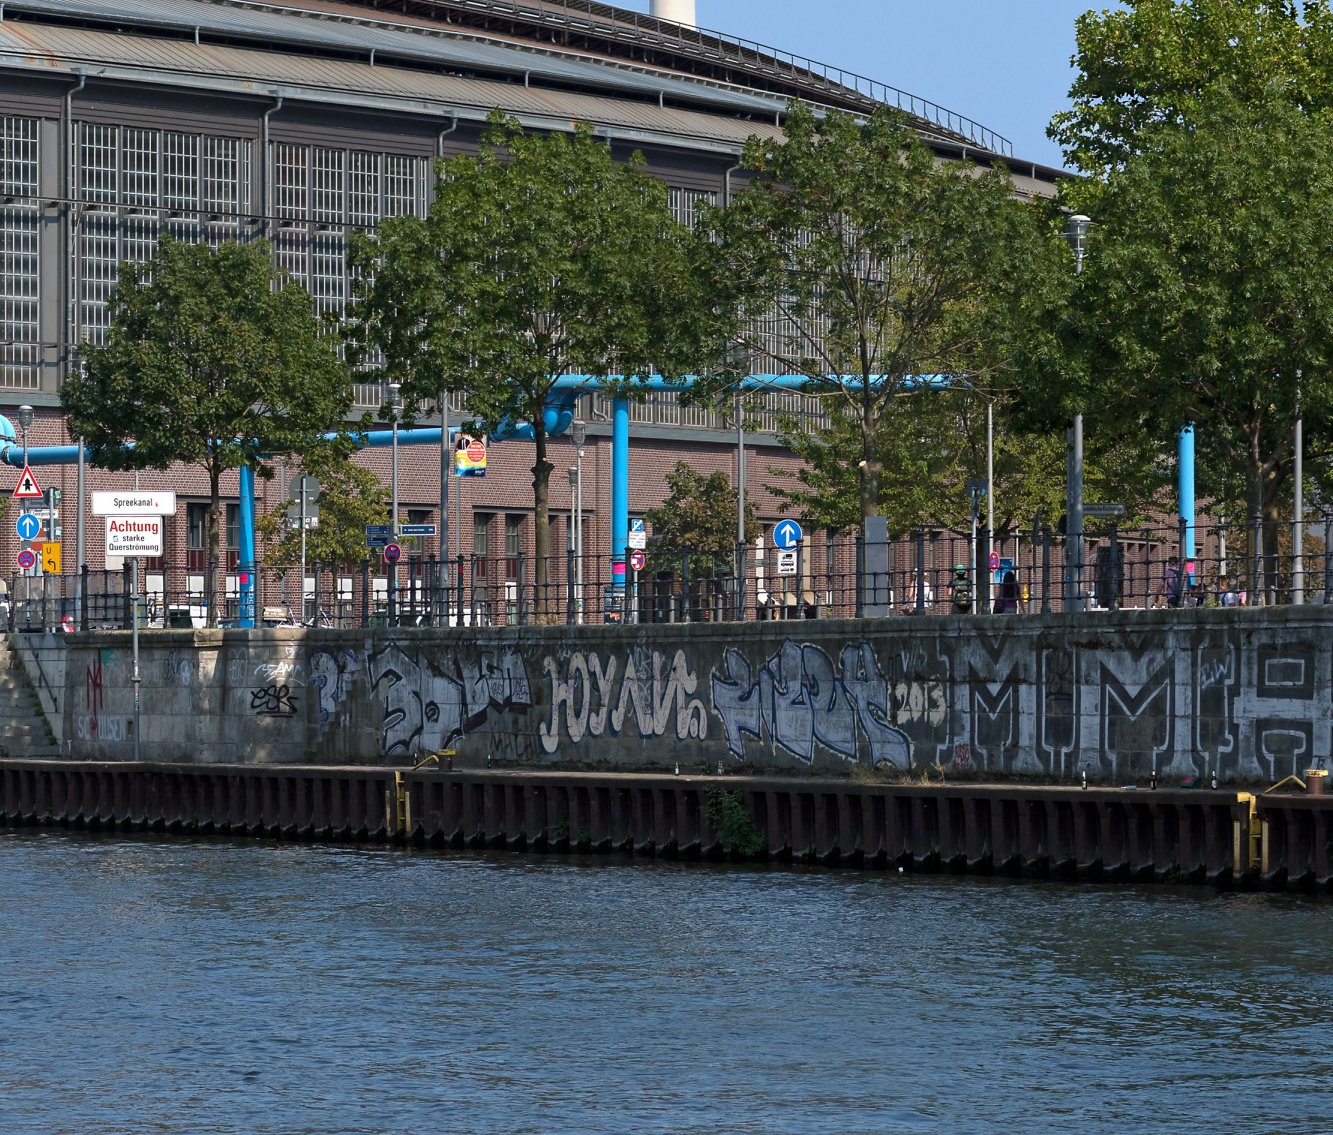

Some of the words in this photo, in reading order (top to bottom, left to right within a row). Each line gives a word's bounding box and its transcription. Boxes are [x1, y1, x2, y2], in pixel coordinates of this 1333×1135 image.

[113, 497, 153, 509] Spreekanal
[109, 520, 159, 535] Achtung
[108, 543, 159, 552] Querströmung
[895, 677, 945, 724] 2013
